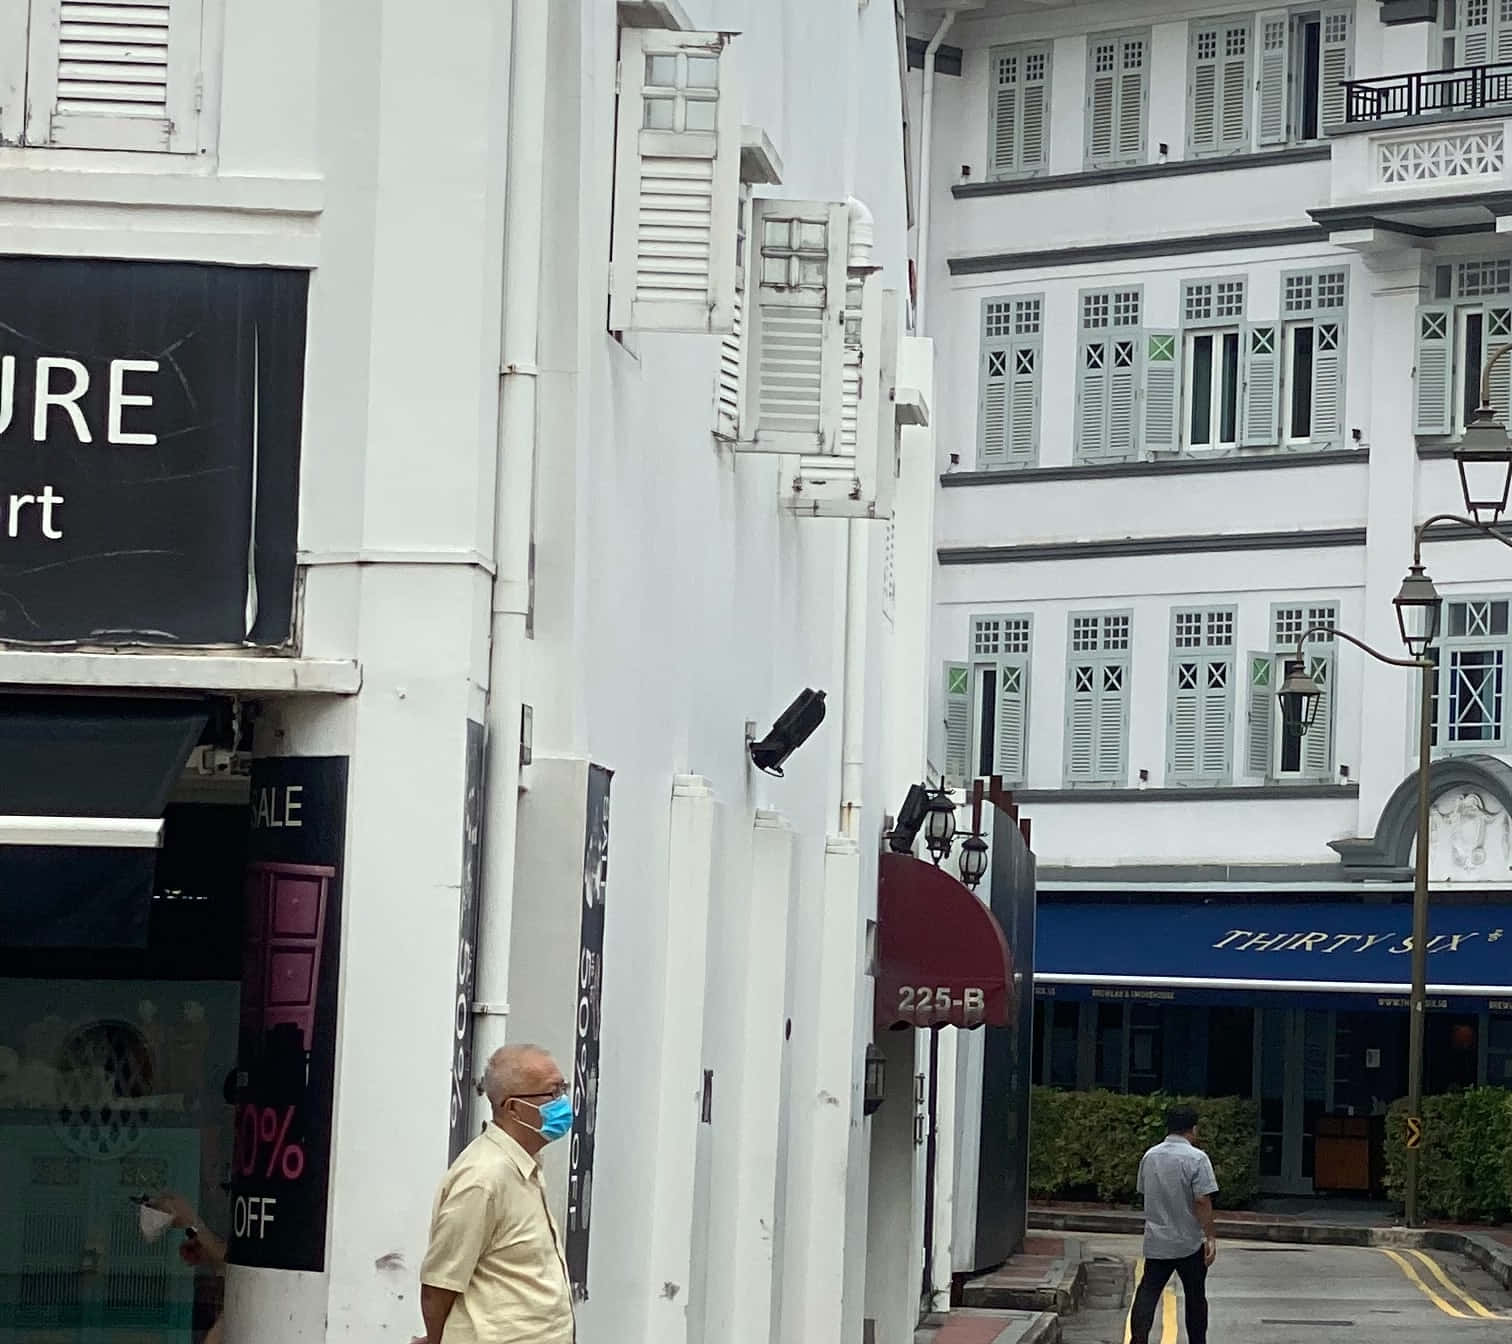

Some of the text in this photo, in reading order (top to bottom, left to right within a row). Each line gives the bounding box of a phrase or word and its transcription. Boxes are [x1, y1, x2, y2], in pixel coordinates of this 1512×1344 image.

[1212, 929, 1397, 954] THIRTY
[1388, 932, 1480, 954] SIX
[898, 986, 985, 1012] 225-B
[574, 946, 592, 1117] 50%
[234, 1195, 276, 1239] OFF
